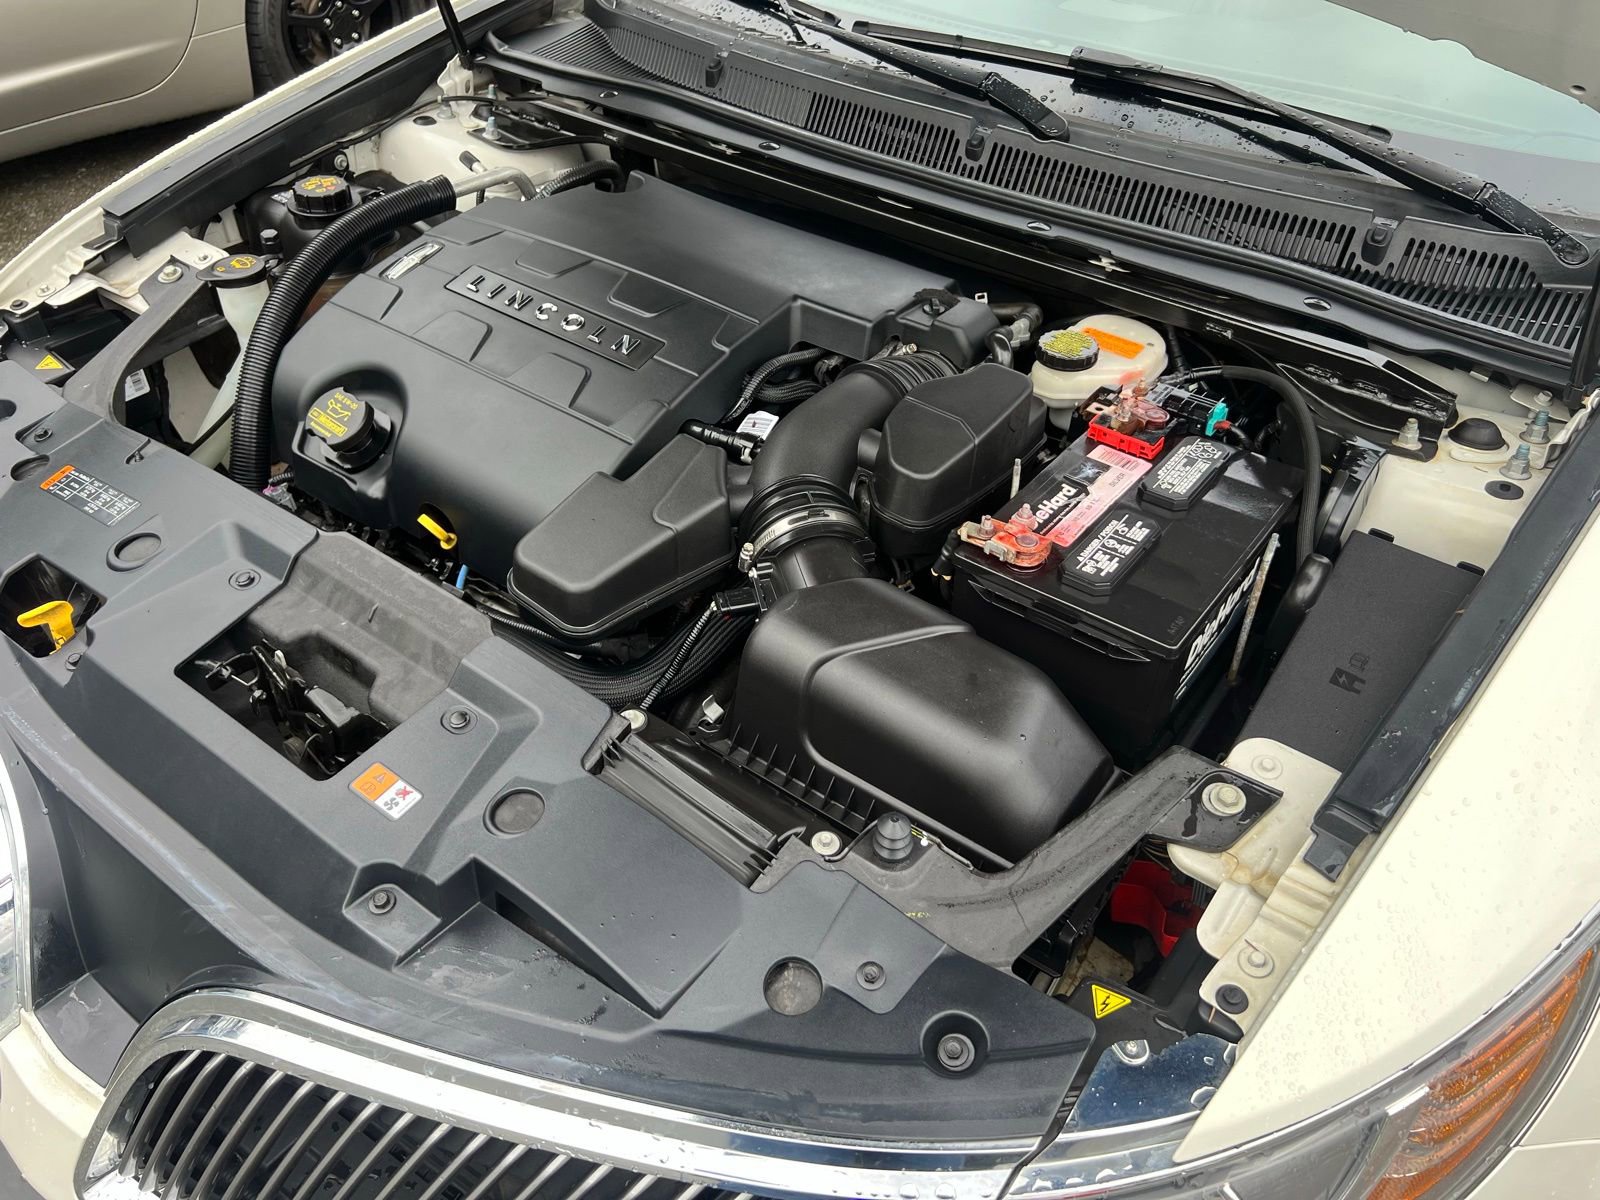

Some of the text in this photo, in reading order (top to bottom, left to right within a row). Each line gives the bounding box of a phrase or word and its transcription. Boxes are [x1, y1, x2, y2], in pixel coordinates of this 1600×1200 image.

[466, 275, 641, 355] LINCOLN
[1033, 483, 1079, 530] ieHard
[1080, 538, 1101, 557] DANGER
[1184, 556, 1261, 671] DieHard
